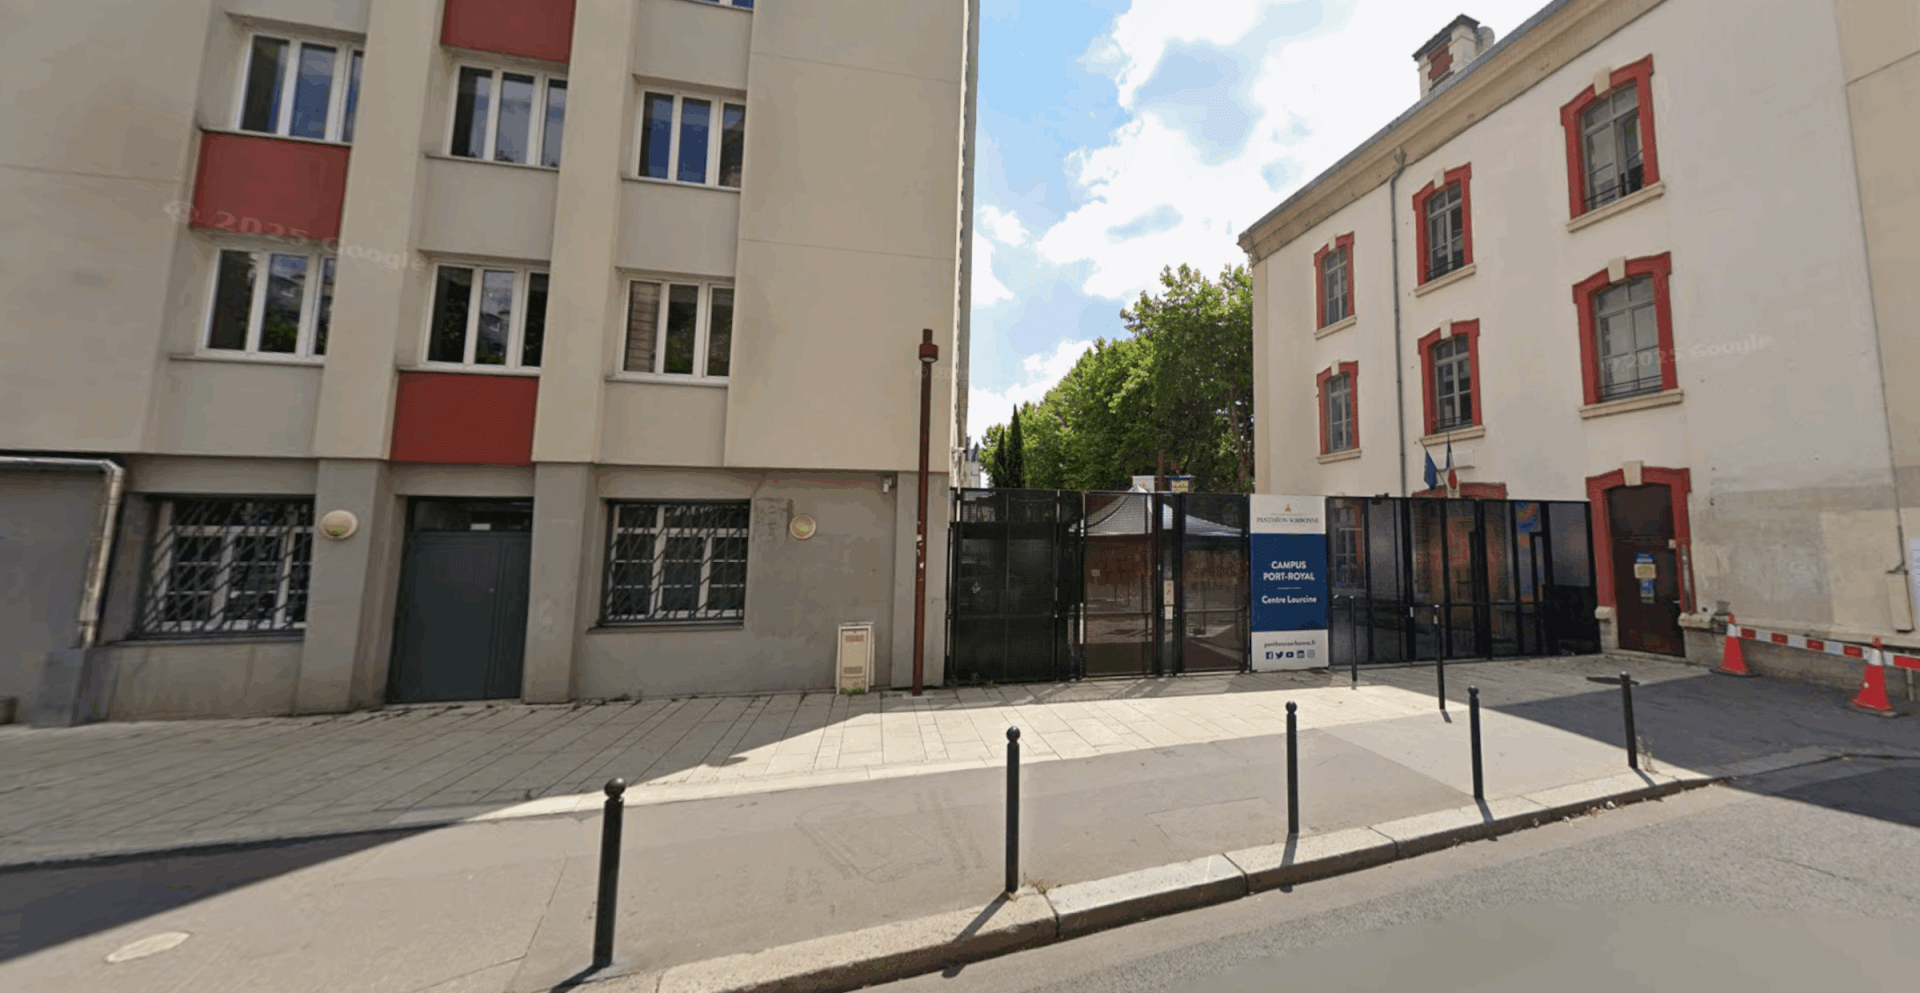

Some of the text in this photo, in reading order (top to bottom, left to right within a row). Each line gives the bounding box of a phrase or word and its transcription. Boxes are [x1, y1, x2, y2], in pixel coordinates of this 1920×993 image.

[1271, 560, 1307, 569] CAMPUS
[1263, 572, 1316, 581] PORT-ROYAL
[1261, 595, 1317, 604] Centre Lourcine
